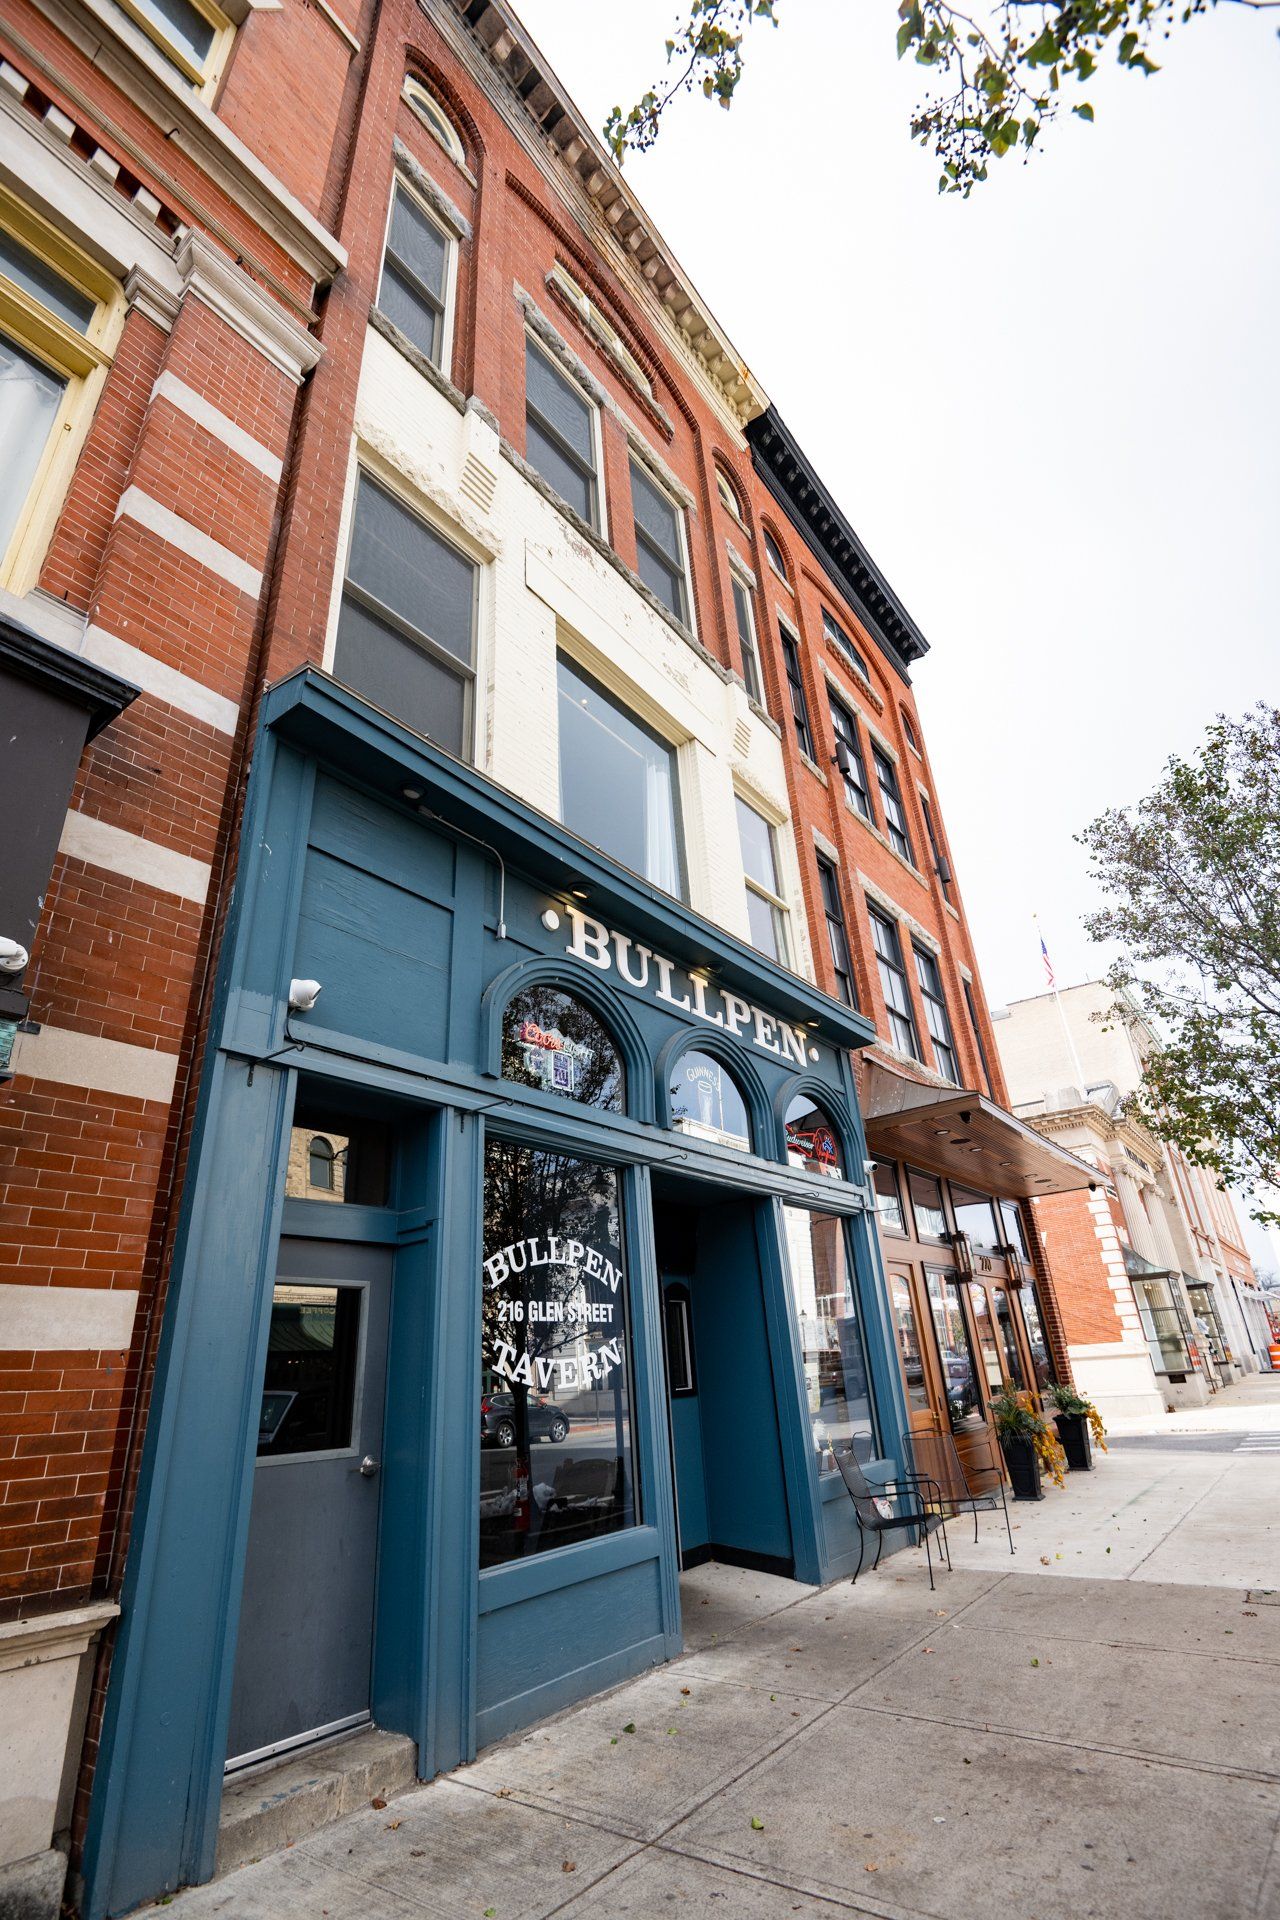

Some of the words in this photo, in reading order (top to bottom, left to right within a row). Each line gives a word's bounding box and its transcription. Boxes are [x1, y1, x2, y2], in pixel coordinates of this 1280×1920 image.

[564, 904, 807, 1067] BULLPEN
[483, 1237, 623, 1294] BULLPEN
[497, 1301, 524, 1322] 216
[528, 1301, 563, 1322] GLEN
[567, 1302, 614, 1323] STREET
[491, 1337, 622, 1389] TAVERN
